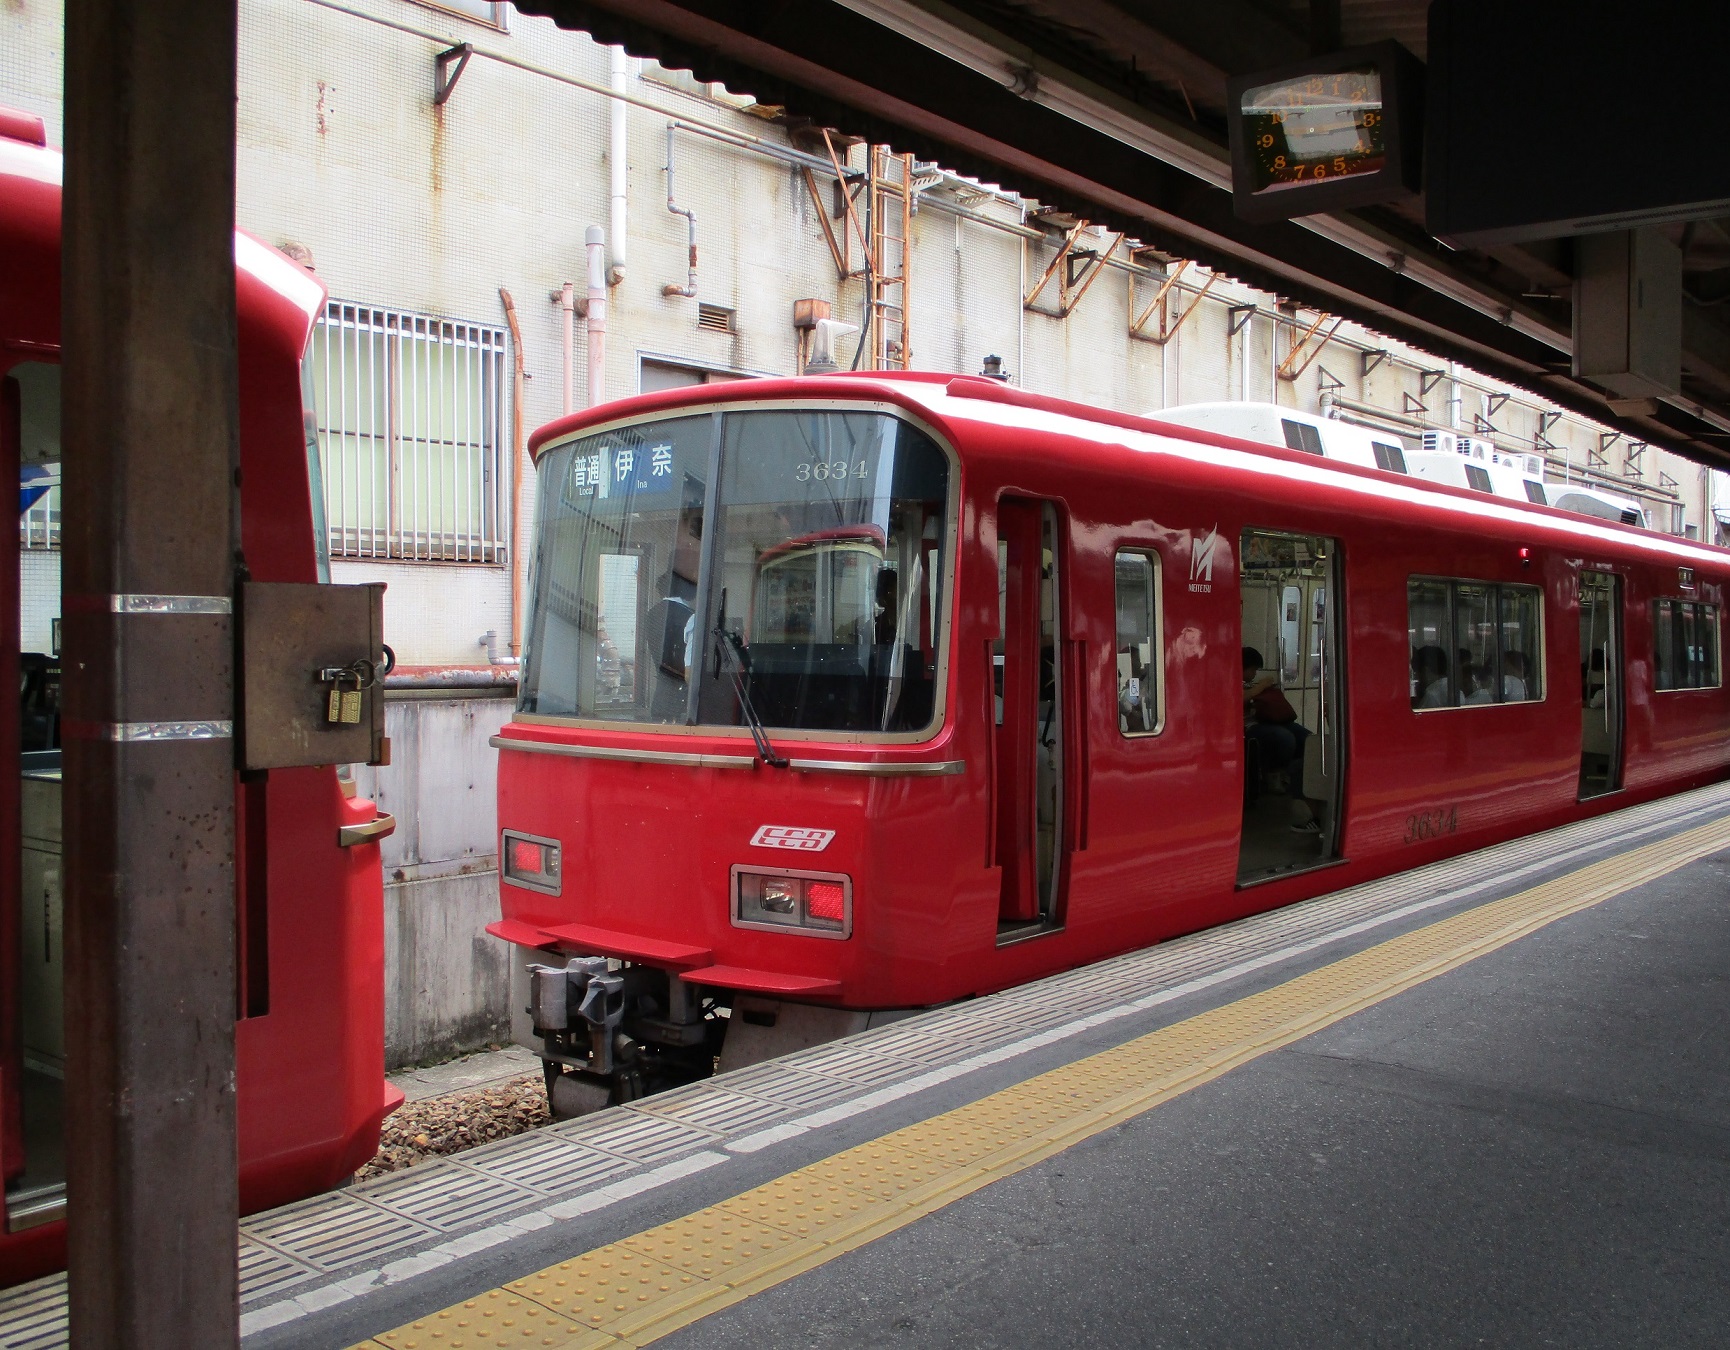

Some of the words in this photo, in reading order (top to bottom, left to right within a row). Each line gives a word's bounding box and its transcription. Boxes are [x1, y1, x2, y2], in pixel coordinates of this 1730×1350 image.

[1305, 81, 1324, 96] 12
[1332, 84, 1340, 96] 1
[1289, 93, 1303, 106] 11
[1351, 91, 1363, 103] 2
[1271, 110, 1288, 125] 10
[1363, 113, 1375, 127] 3
[1262, 134, 1274, 148] 9
[1354, 140, 1365, 153] 4
[1274, 155, 1286, 169] 8
[1333, 157, 1346, 172] 5
[1293, 165, 1305, 179] 7
[1314, 164, 1326, 178] 6
[574, 455, 599, 487] 普通
[796, 460, 868, 482] 3634
[579, 486, 594, 496] Local
[637, 480, 648, 488] Ina
[1188, 583, 1212, 593] MEITETSU
[1404, 804, 1457, 844] 3634
